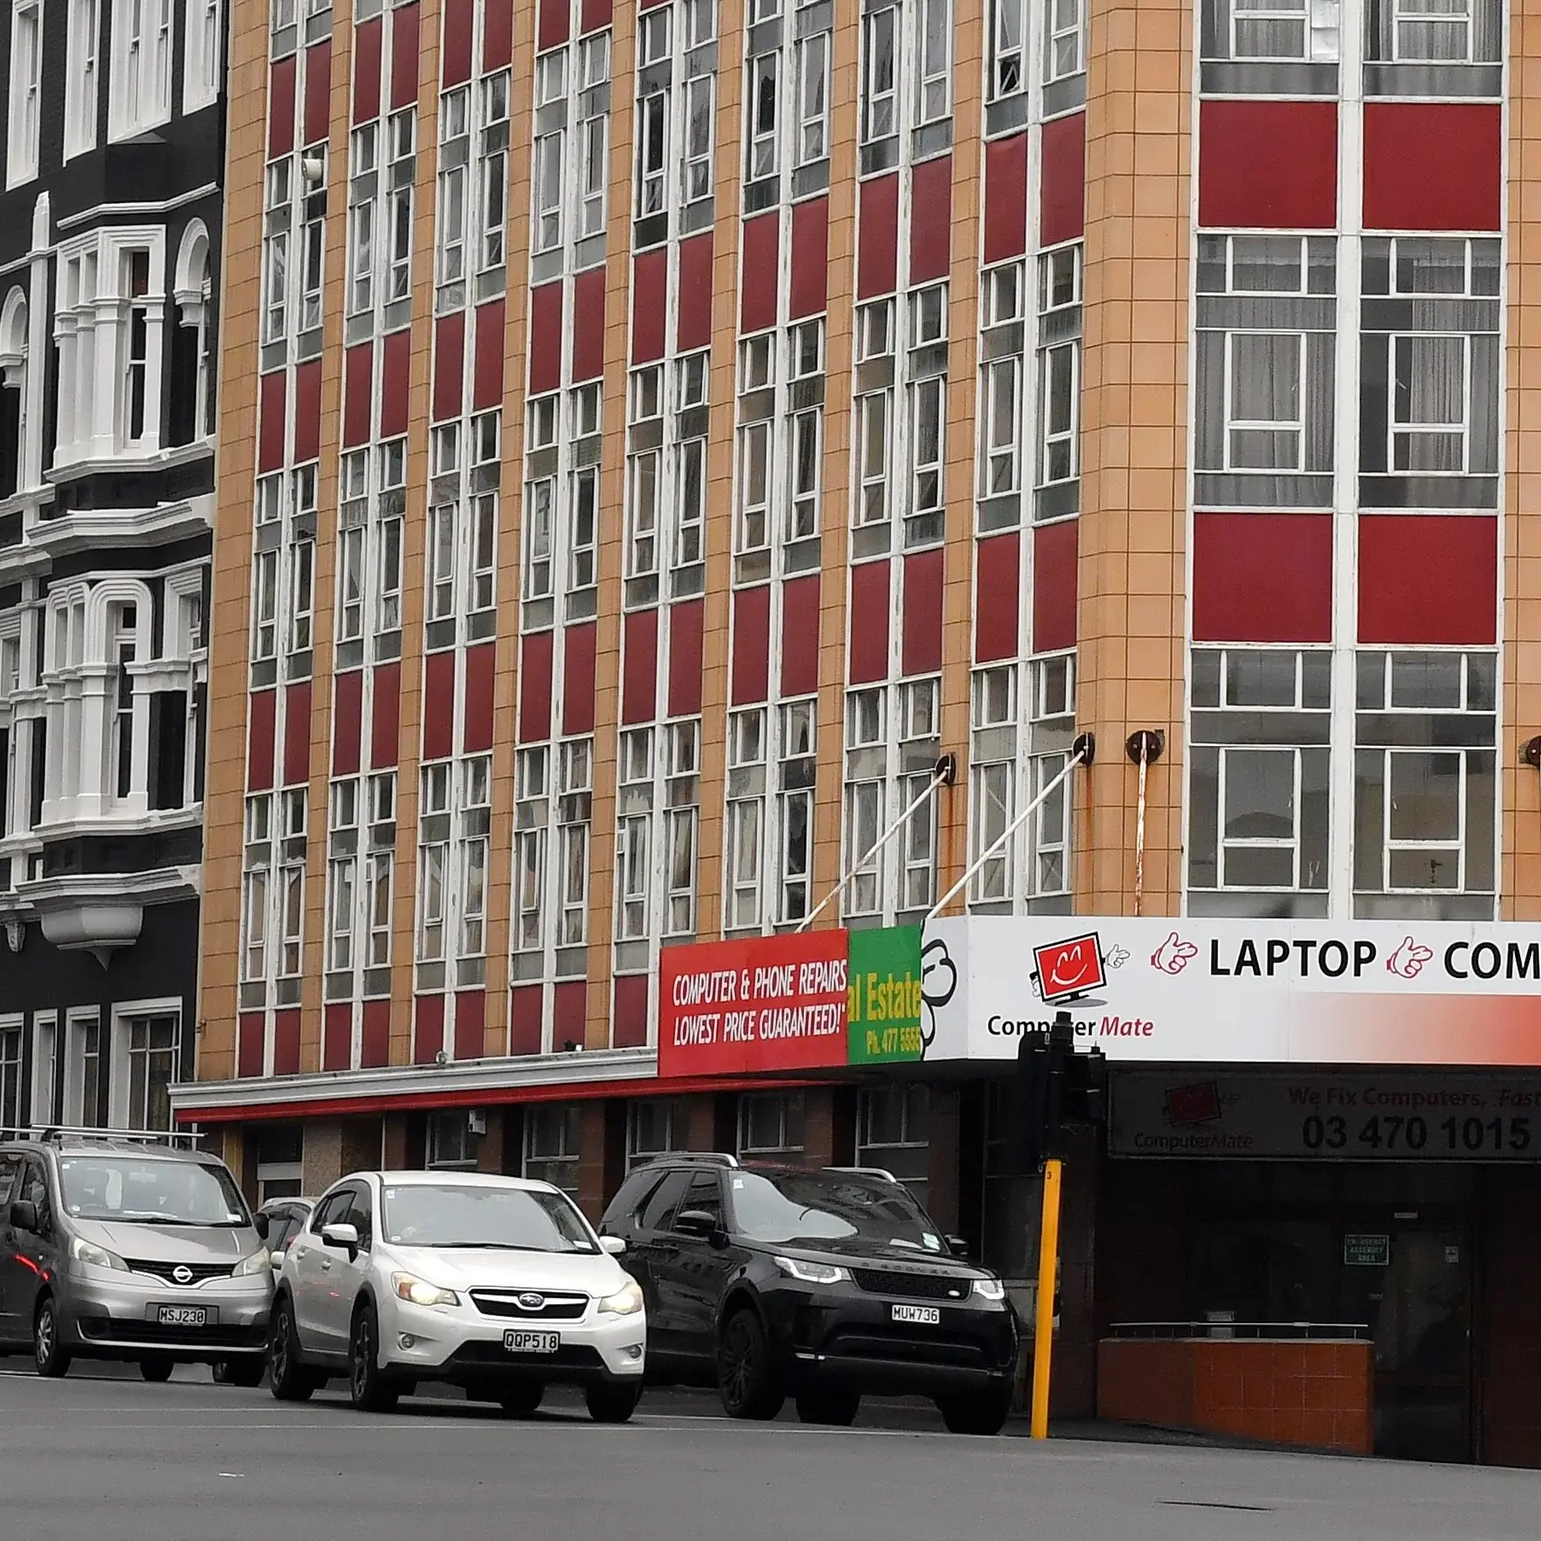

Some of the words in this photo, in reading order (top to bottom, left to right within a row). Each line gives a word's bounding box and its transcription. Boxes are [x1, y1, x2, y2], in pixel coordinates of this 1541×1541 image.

[1210, 939, 1377, 977] LAPTOP
[673, 968, 736, 1006] COMPUTER
[741, 972, 750, 1001] &
[754, 964, 796, 999] PHONE
[799, 959, 848, 996] REPAIRS
[867, 972, 921, 1021] Estate
[673, 1014, 720, 1046] LOWEST
[723, 1011, 755, 1042] PRICE
[882, 1027, 898, 1053] 477
[987, 1015, 1096, 1036] Comper
[1099, 1016, 1154, 1036] Mate
[1288, 1086, 1319, 1107] We
[1327, 1086, 1356, 1107] Fix
[1499, 1088, 1541, 1108] Fast
[1302, 1116, 1347, 1150] 03
[1358, 1116, 1427, 1150] 470
[1441, 1116, 1531, 1151] 1015
[893, 1306, 938, 1322] MUW736
[506, 1333, 557, 1349] QQP518
